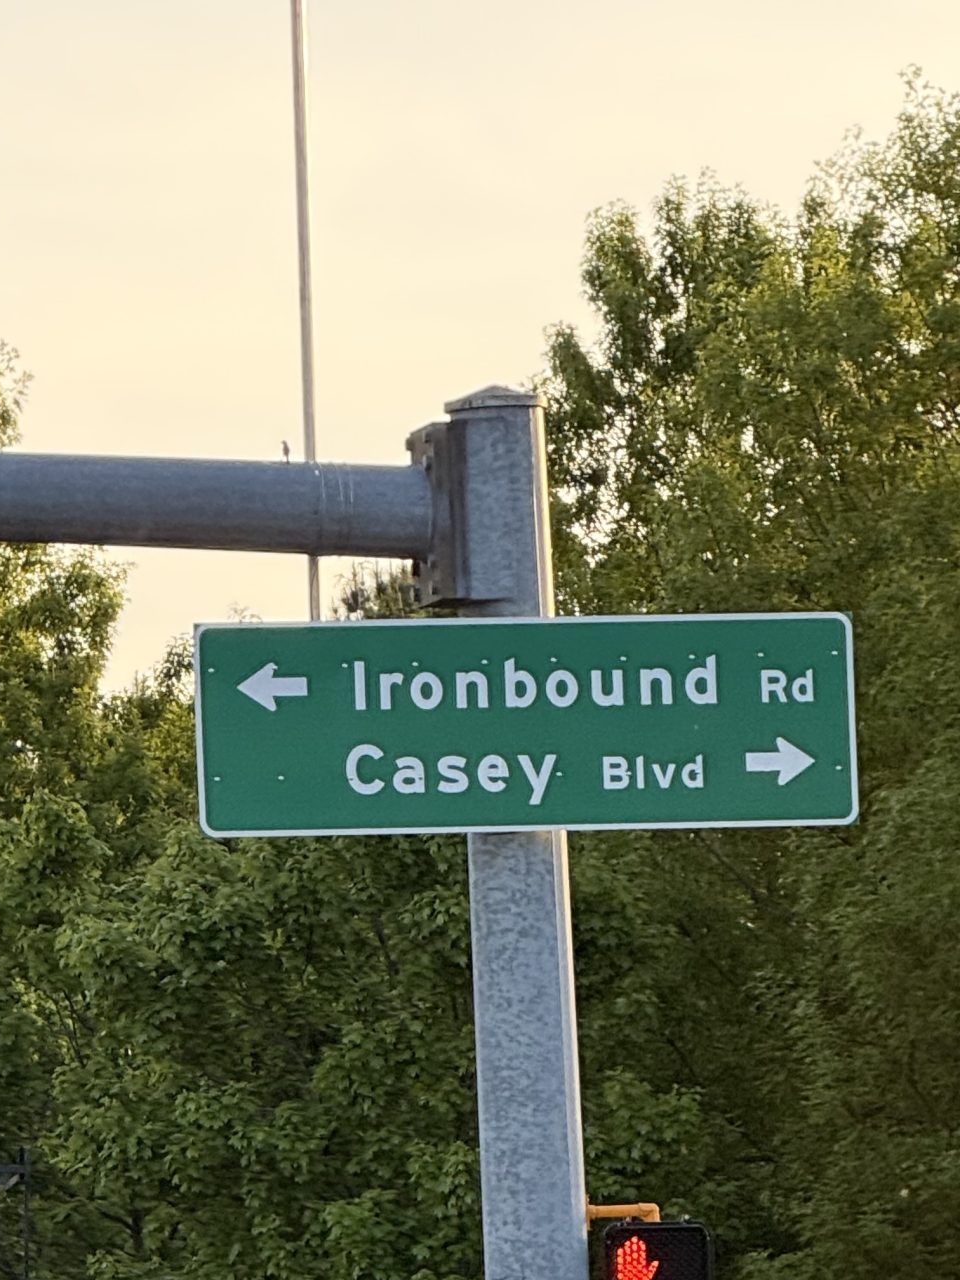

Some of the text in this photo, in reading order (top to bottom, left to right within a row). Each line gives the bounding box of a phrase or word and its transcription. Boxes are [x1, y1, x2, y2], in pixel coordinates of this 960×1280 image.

[354, 656, 814, 710] Ironbound Rd
[345, 744, 704, 805] Casey Blvd
